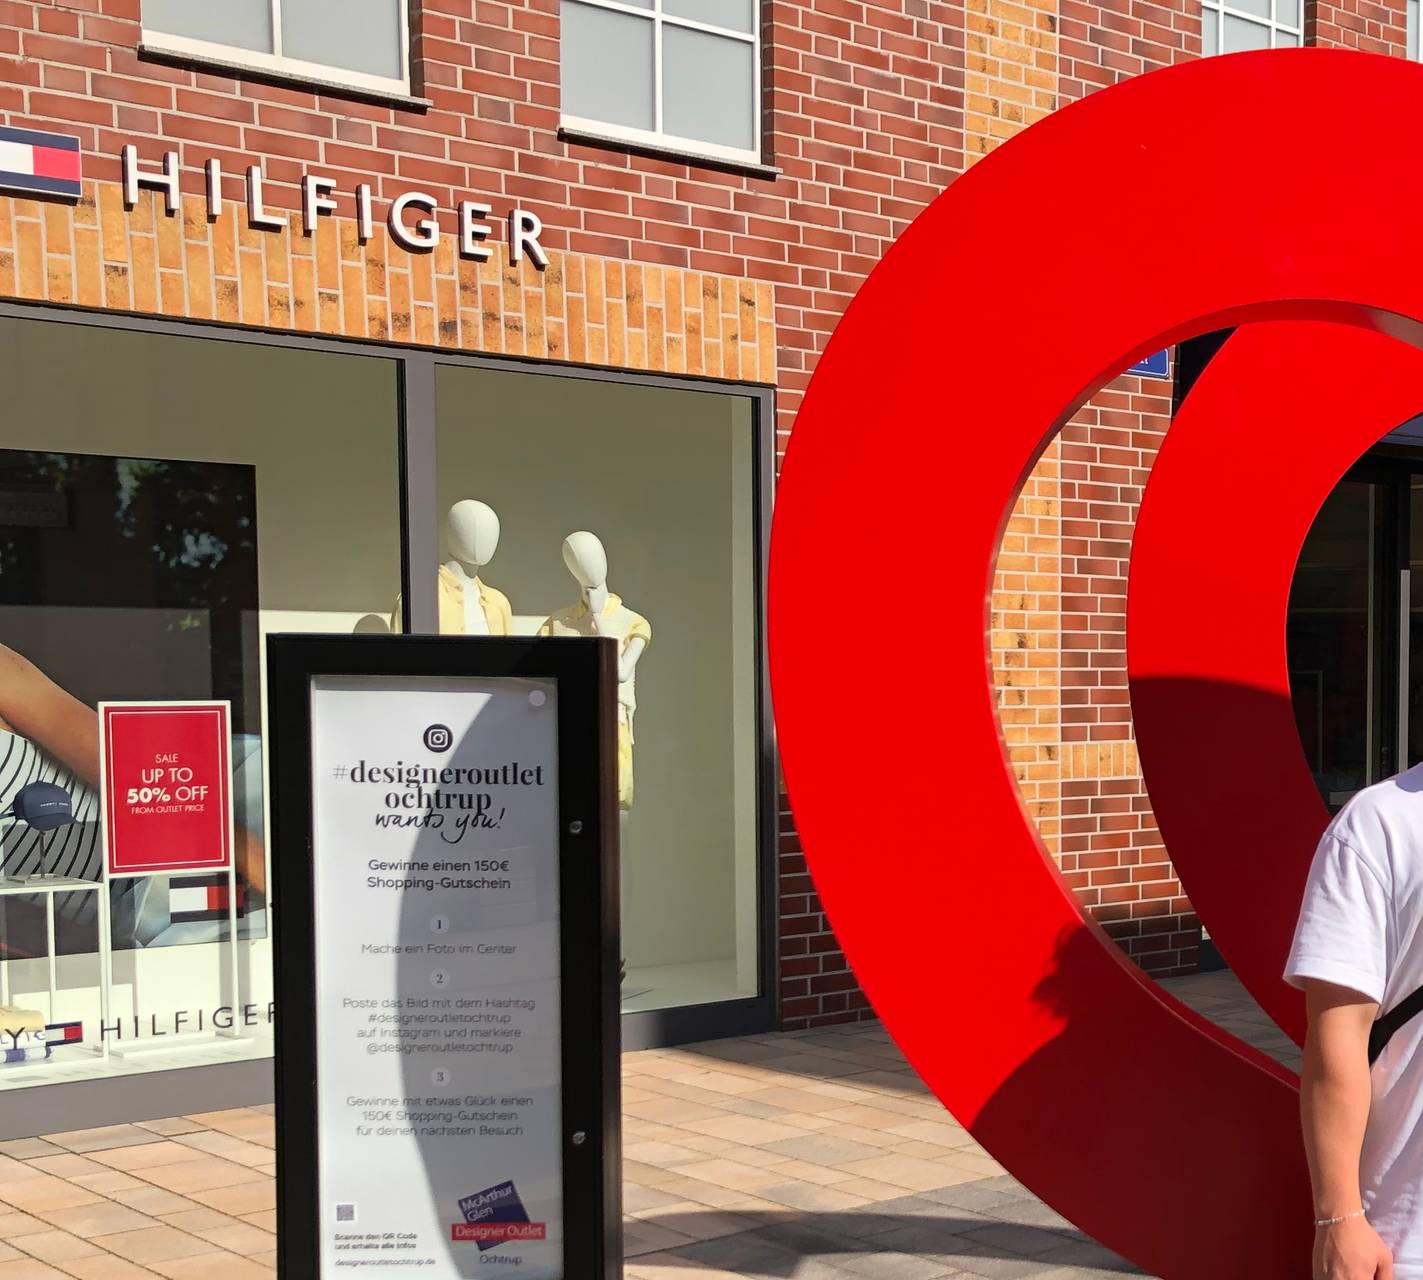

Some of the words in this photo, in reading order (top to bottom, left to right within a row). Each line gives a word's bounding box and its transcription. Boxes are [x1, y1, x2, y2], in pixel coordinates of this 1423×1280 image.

[122, 144, 549, 268] HILFIGER
[155, 753, 179, 763] SALE
[141, 768, 164, 784] UP
[168, 767, 193, 783] TO
[332, 760, 544, 788] #designeroutlet
[127, 787, 171, 804] 50%
[175, 786, 208, 801] OFF
[385, 786, 492, 813] ochtrup
[131, 806, 154, 814] FROM
[156, 805, 182, 813] OUTLET
[185, 804, 204, 812] PRICE
[376, 809, 444, 828] wants
[441, 808, 506, 844] you!
[368, 859, 429, 871] Gewinne
[433, 859, 470, 871] einen
[474, 860, 510, 872] 150€
[367, 876, 511, 891] Shopping-Gutschein
[361, 944, 402, 954] Mache
[405, 944, 424, 954] ein
[426, 944, 455, 954] Foto
[459, 944, 473, 954] im
[477, 944, 517, 954] Center
[436, 973, 443, 983] 2
[343, 998, 378, 1009] Poste
[381, 998, 402, 1008] das
[406, 998, 428, 1008] Bild
[432, 998, 452, 1008] mit
[456, 998, 482, 1008] dem
[485, 998, 536, 1011] Hashtag
[368, 1012, 511, 1024] #designeroutletochtrup
[357, 1027, 376, 1038] auf
[380, 1027, 440, 1040] Instagram
[444, 1027, 467, 1038] und
[470, 1027, 522, 1038] markiere
[366, 1041, 513, 1054] @designeroutletochtrup
[436, 1071, 444, 1082] 3
[346, 1096, 399, 1106] Gewinne
[403, 1096, 421, 1106] mit
[425, 1096, 461, 1106] etwas
[464, 1095, 497, 1106] Glück
[500, 1096, 534, 1106] einen
[362, 1111, 392, 1121] 150€
[396, 1110, 518, 1123] Shopping-Gutschein
[376, 1126, 416, 1136] deinen
[480, 1126, 523, 1136] Besuch
[462, 1185, 513, 1212] McArthur
[467, 1206, 494, 1222] Glen
[455, 1225, 505, 1239] Designer
[507, 1225, 543, 1236] Outlet
[479, 1254, 523, 1267] Ochtrup
